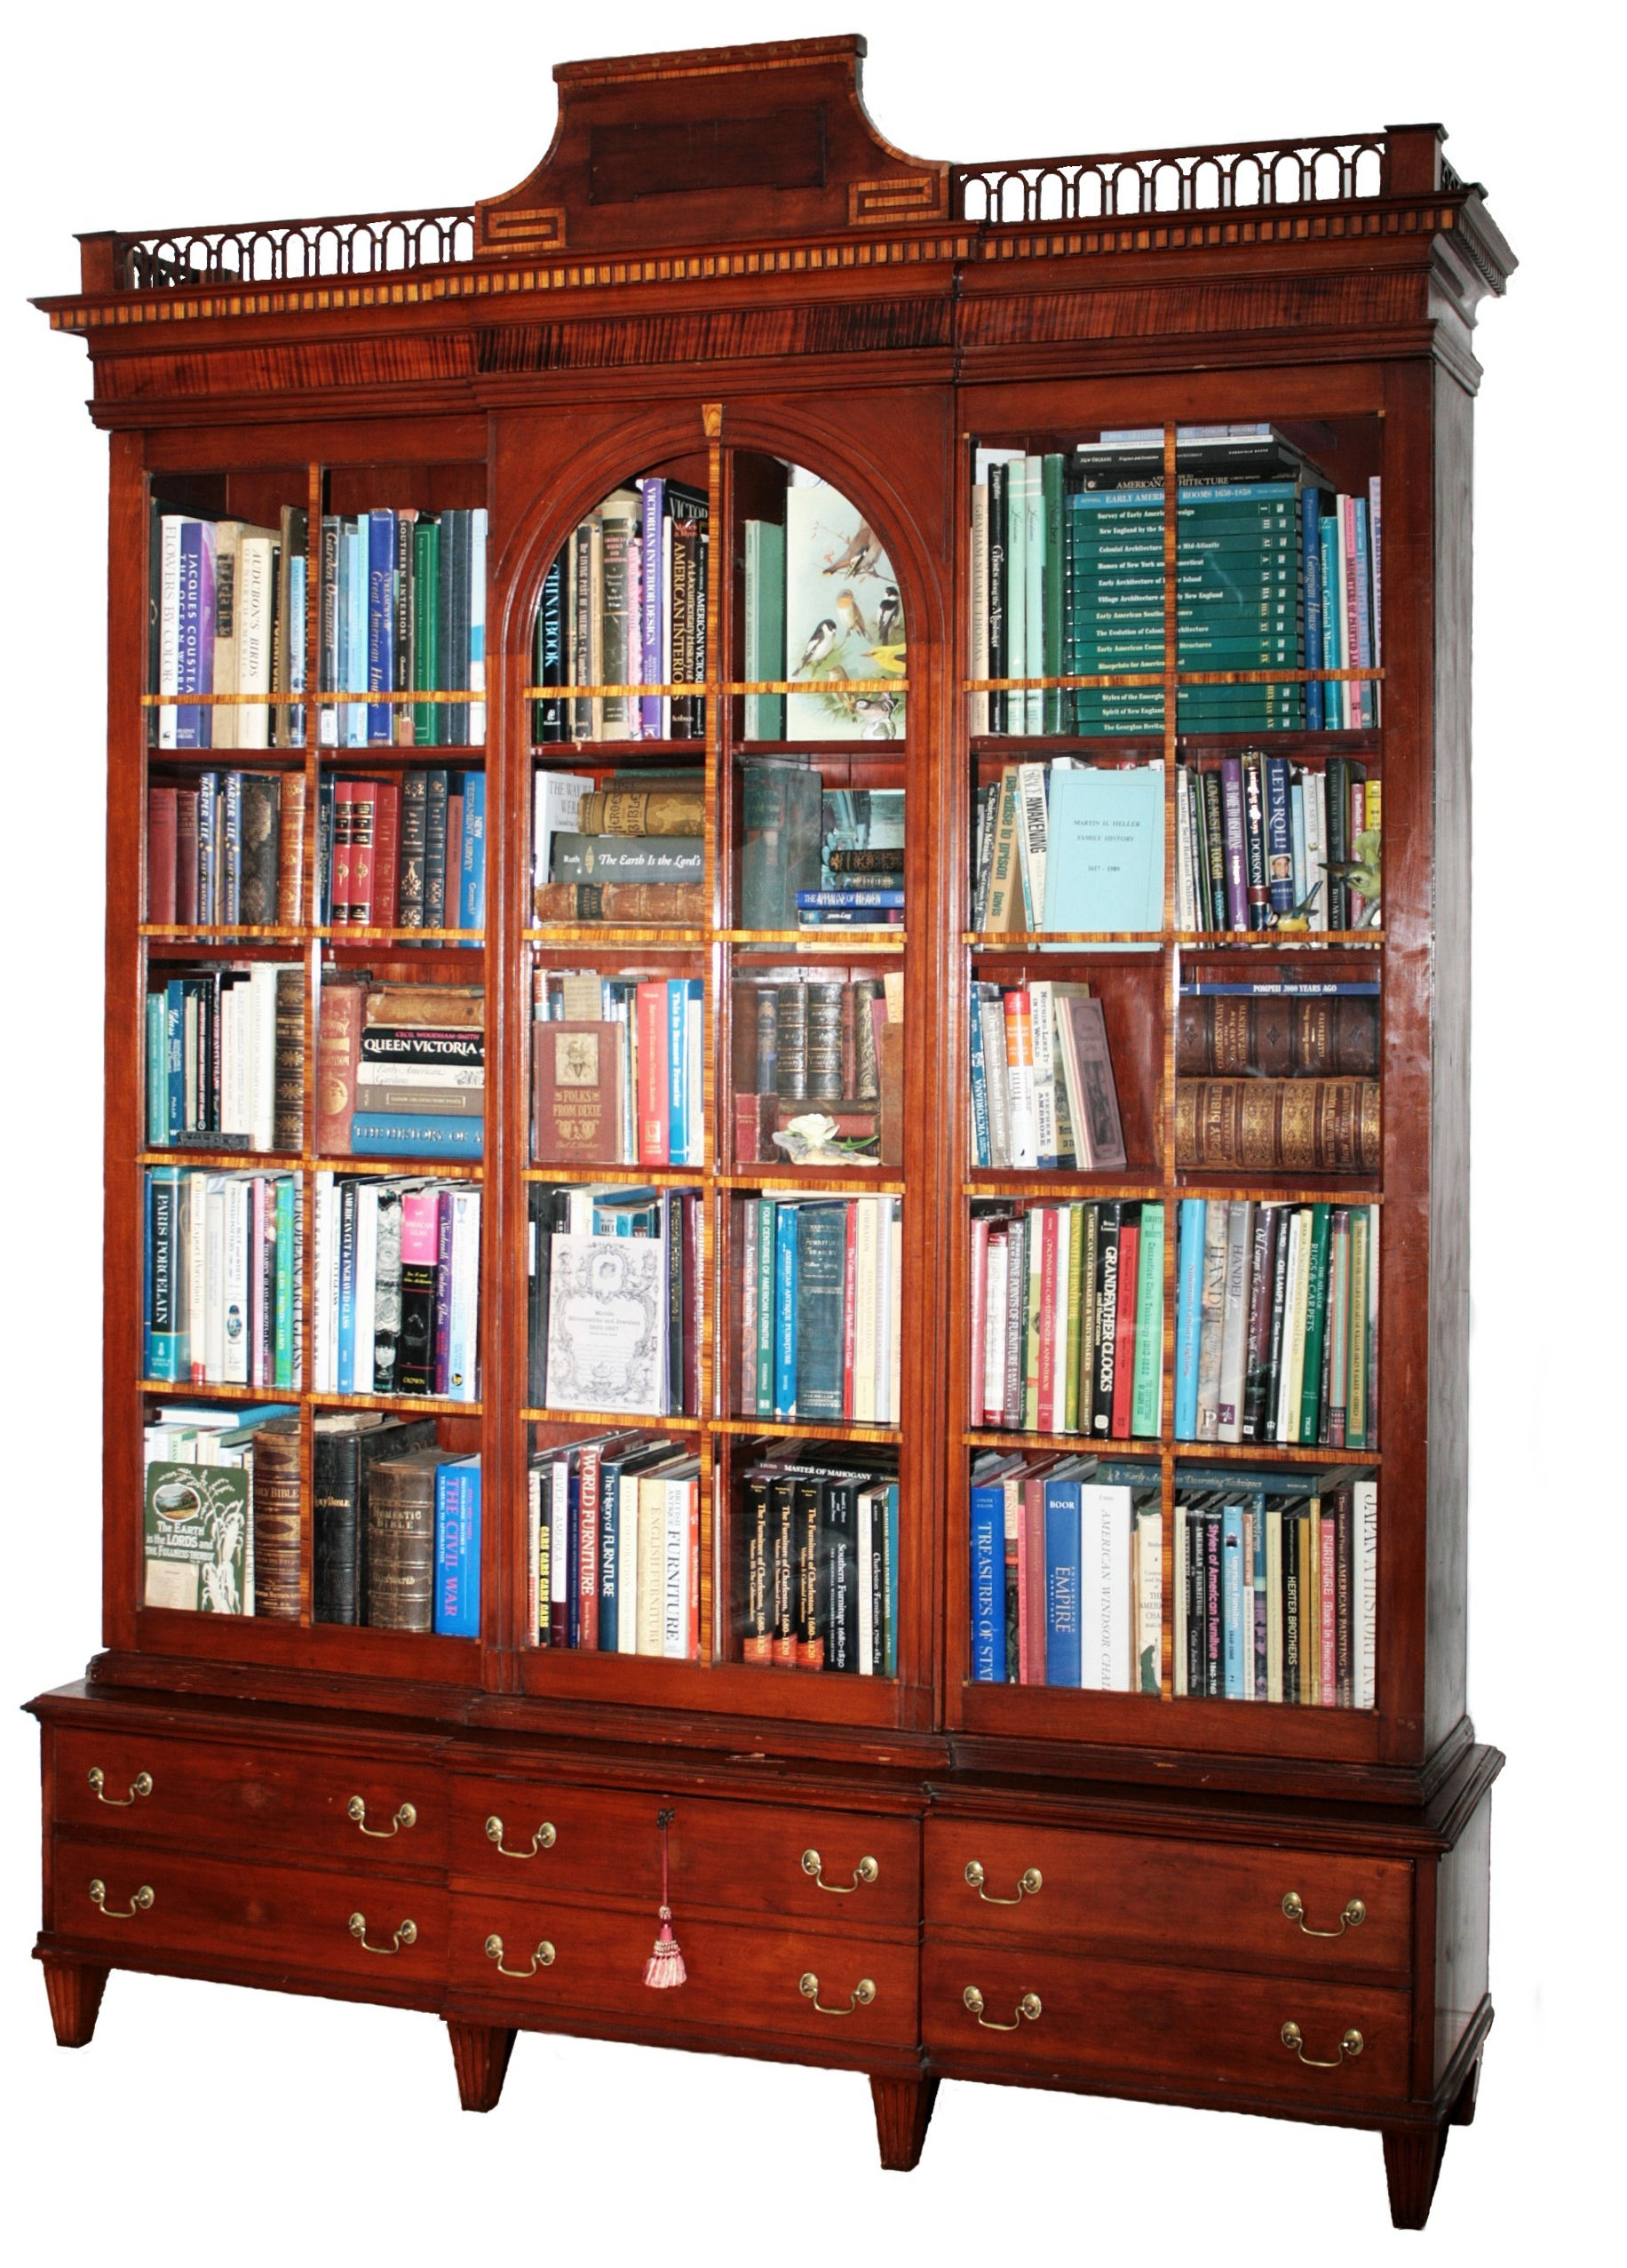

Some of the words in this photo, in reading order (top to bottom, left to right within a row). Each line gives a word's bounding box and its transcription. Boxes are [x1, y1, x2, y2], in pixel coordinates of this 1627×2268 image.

[974, 505, 984, 551] GRAHAM
[1049, 505, 1060, 544] Natchez
[163, 527, 176, 600] FLOWERS
[325, 532, 337, 579] Garden
[251, 550, 260, 630] AUDUBON'S
[647, 550, 655, 602] INTERIOR
[974, 555, 983, 608] STUART
[163, 607, 175, 623] BY
[325, 583, 334, 649] Ornament
[647, 605, 655, 645] DESIGN
[162, 630, 175, 682] COLOR
[250, 639, 258, 677] BIRDS
[545, 619, 559, 667] BOOK
[1003, 776, 1016, 825] paradise
[1207, 780, 1218, 804] LOVE
[1272, 768, 1285, 805] LET'S
[1001, 829, 1012, 839] to
[1208, 806, 1218, 830] MUST
[1269, 808, 1288, 848] ROLL!
[1211, 833, 1221, 845] BE
[564, 855, 581, 863] Ruth
[599, 854, 617, 865] The
[620, 854, 645, 865] Earth
[647, 855, 655, 865] Is
[657, 855, 671, 865] the
[673, 854, 701, 866] Lord's
[996, 843, 1011, 879] prison
[1211, 847, 1223, 879] TOUGH
[1250, 838, 1261, 884] DOBSON
[993, 892, 1004, 917] Davis
[1215, 892, 1224, 919] DOBSON
[169, 1009, 179, 1036] Glass
[673, 1016, 680, 1028] So
[364, 1039, 411, 1053] QUEEN
[413, 1040, 478, 1056] VICTORIA
[376, 1076, 409, 1085] Gardens
[562, 1091, 591, 1102] FOLKS
[355, 1126, 383, 1137] THE
[386, 1128, 443, 1141] HISTORY
[449, 1130, 467, 1142] OF
[158, 1195, 169, 1236] PARIS
[194, 1181, 203, 1220] Chinese
[345, 1191, 353, 1232] AMERICAN
[193, 1223, 203, 1255] Export
[343, 1235, 353, 1251] CUT
[439, 1216, 450, 1260] Nineteenth
[1308, 1244, 1318, 1270] RUGS
[156, 1241, 168, 1324] PORCELAIN
[194, 1259, 202, 1304] Porcelain
[342, 1260, 352, 1303] ENGRAVED
[438, 1264, 448, 1297] Century
[745, 1245, 755, 1285] American
[763, 1263, 770, 1272] OF
[1010, 1259, 1019, 1278] FINE
[1085, 1253, 1094, 1306] CLOCKMAKERS
[1308, 1273, 1317, 1282] &
[745, 1287, 756, 1327] Furniture
[783, 1289, 792, 1321] ANTIQUE
[1009, 1279, 1020, 1308] POINTS
[1101, 1246, 1117, 1341] GRANDFATHER
[1275, 1279, 1284, 1303] LAMPS
[1306, 1285, 1316, 1332] CARPETS
[1316, 1301, 1322, 1309] OF
[342, 1304, 352, 1329] GLASS
[437, 1301, 448, 1325] Glass
[1009, 1309, 1019, 1320] OF
[1007, 1321, 1018, 1366] FURNITURE
[1100, 1341, 1114, 1392] CLOCKS
[582, 1453, 596, 1507] WORLD
[605, 1476, 615, 1492] The
[784, 1465, 814, 1475] MASTER
[827, 1469, 871, 1481] MAHOGANY
[446, 1478, 459, 1516] THE
[602, 1492, 615, 1521] History
[1050, 1500, 1075, 1509] BOOR
[157, 1521, 172, 1532] The
[174, 1523, 205, 1536] EARTH
[445, 1521, 458, 1571] CIVIL
[605, 1522, 615, 1532] of
[1101, 1509, 1111, 1580] AMERICAN
[1207, 1524, 1218, 1554] Styles
[581, 1509, 595, 1596] FURNITURE
[604, 1535, 615, 1597] FURNITURE
[837, 1543, 846, 1582] Southern
[978, 1522, 992, 1615] TREASURES
[1209, 1555, 1218, 1565] of
[445, 1577, 457, 1617] WAR
[540, 1578, 549, 1602] CARS
[665, 1531, 680, 1640] FURNITURE
[1055, 1566, 1071, 1633] EMPIRE
[1209, 1566, 1218, 1615] American
[1287, 1576, 1297, 1613] HERTER
[540, 1604, 549, 1627] CARS
[837, 1585, 846, 1625] Furniture
[1101, 1587, 1111, 1648] WINDSOR
[978, 1620, 992, 1642] OF
[1208, 1618, 1218, 1659] Furniture
[1288, 1616, 1297, 1665] BROTHERS
